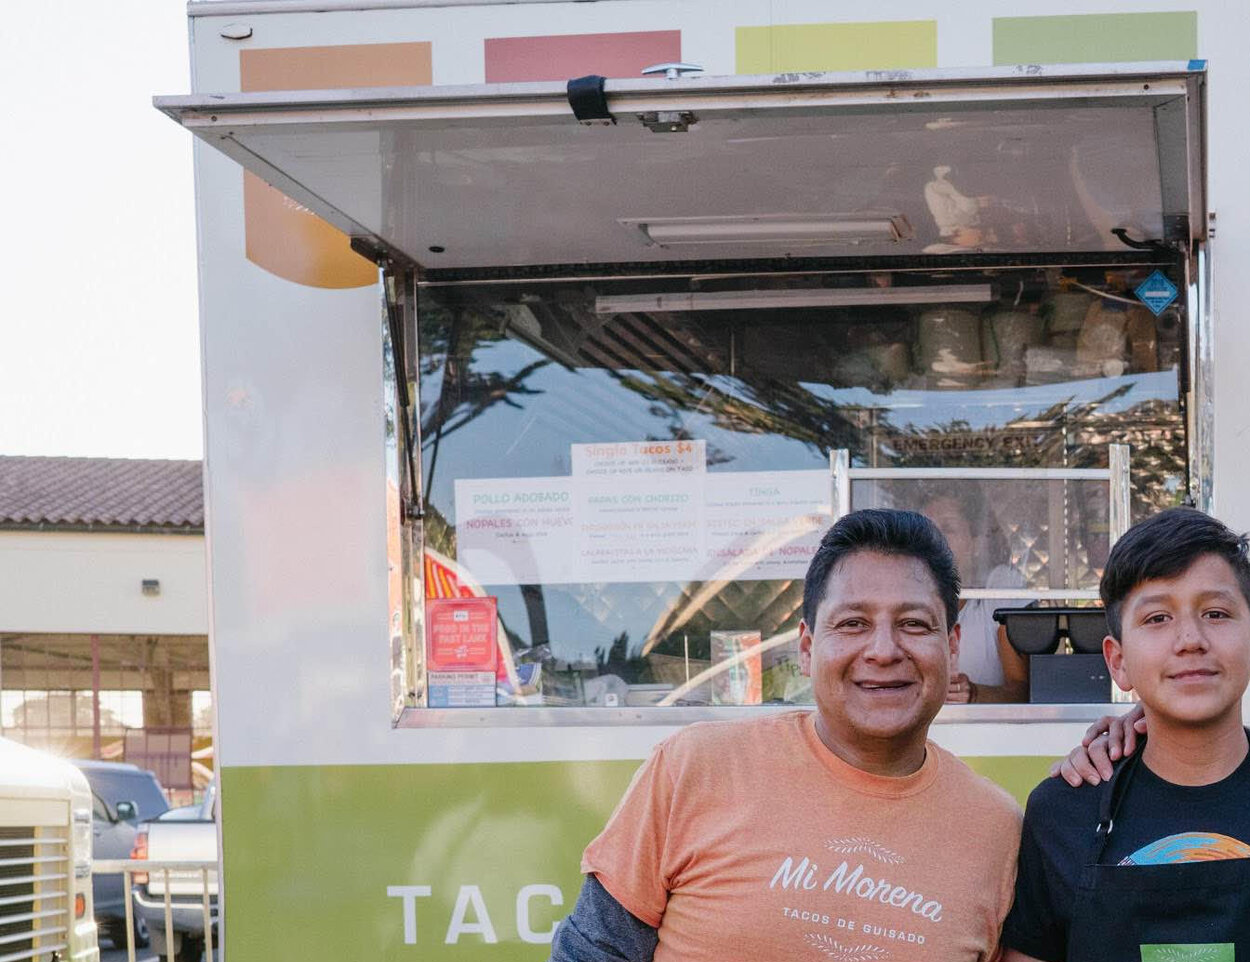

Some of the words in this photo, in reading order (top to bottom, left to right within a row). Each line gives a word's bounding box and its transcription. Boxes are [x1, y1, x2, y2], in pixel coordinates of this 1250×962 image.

[632, 442, 671, 455] Tacos
[676, 441, 694, 454] $4
[893, 437, 995, 451] EMERGENCY
[473, 494, 510, 505] POLLO
[514, 491, 570, 504] ADOBADO
[466, 518, 512, 529] NOPALES
[516, 518, 538, 528] CON
[770, 857, 817, 891] Mi
[823, 860, 943, 923] Morena
[783, 906, 830, 925] TACOS
[837, 918, 855, 931] DE
[863, 923, 926, 946] GUISADO
